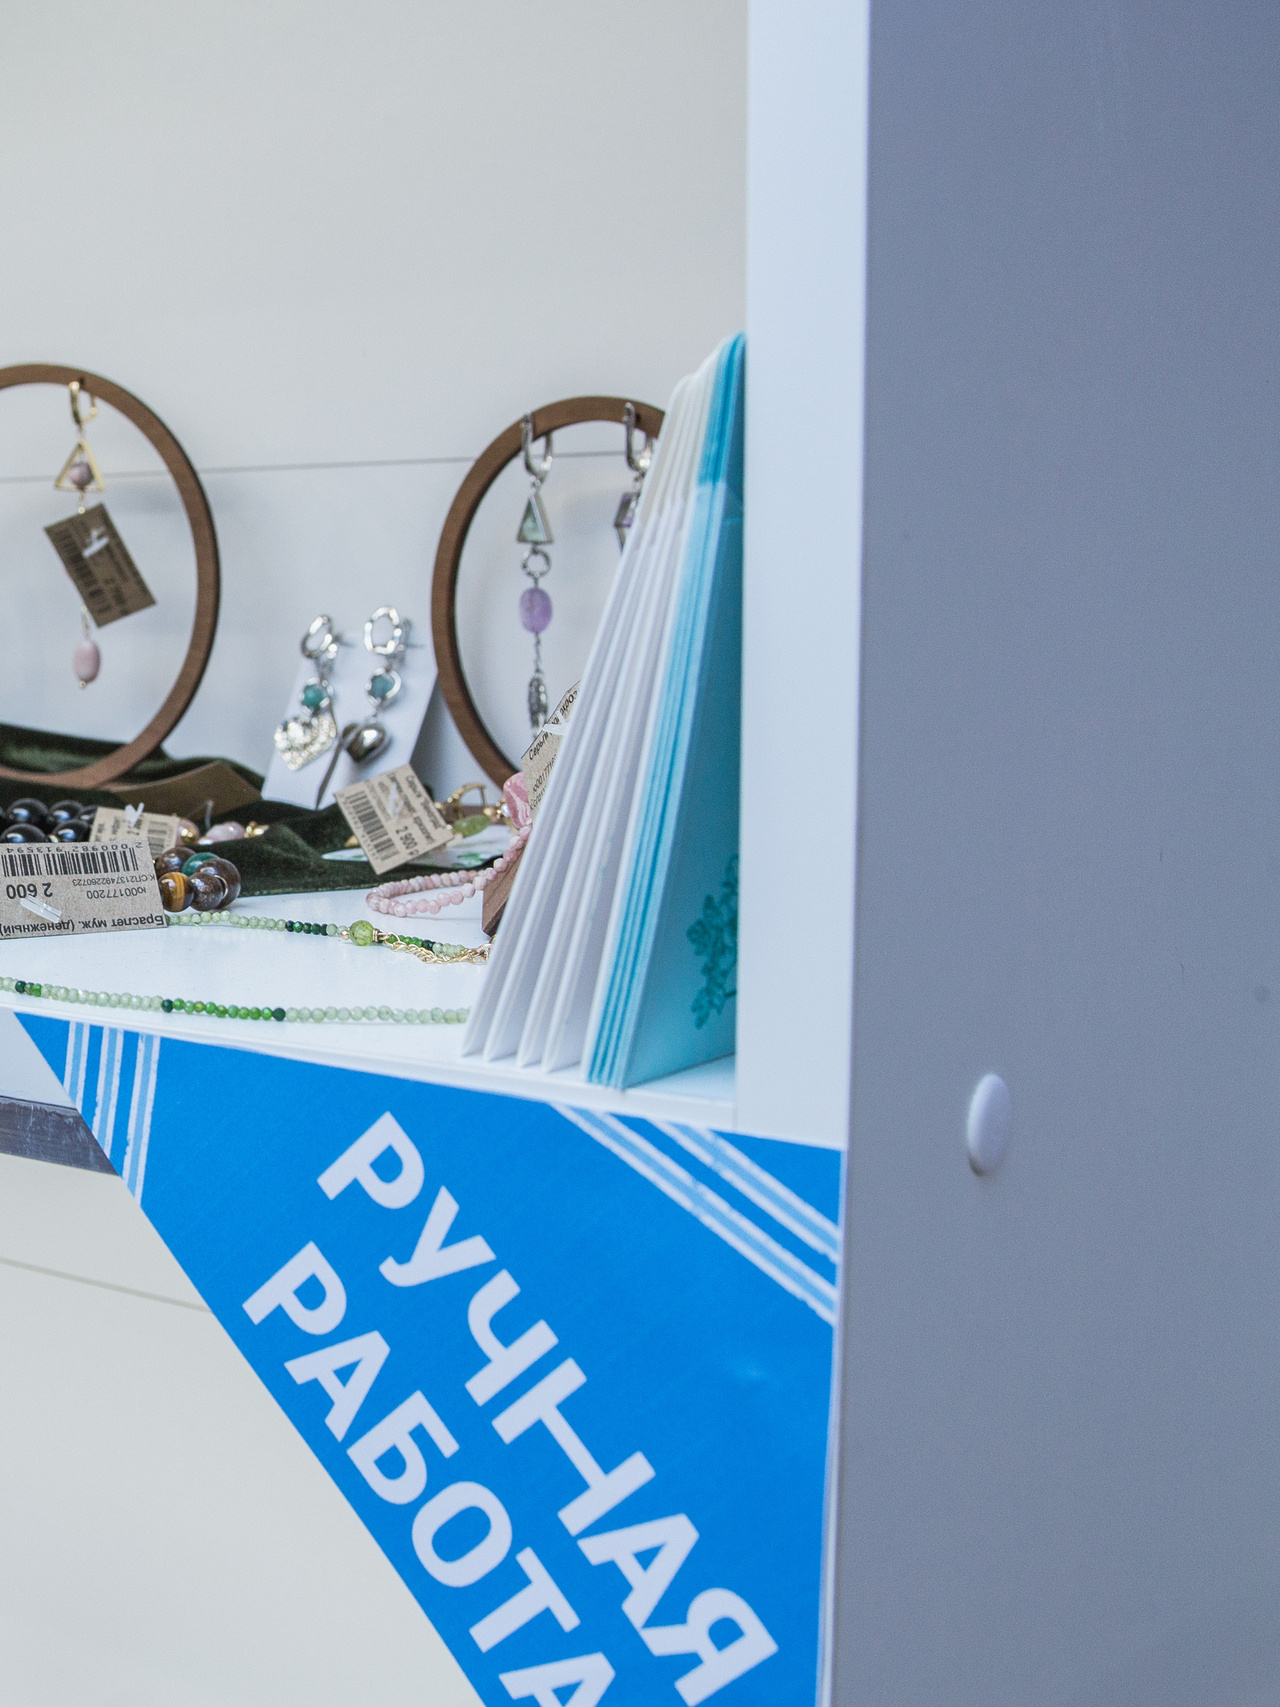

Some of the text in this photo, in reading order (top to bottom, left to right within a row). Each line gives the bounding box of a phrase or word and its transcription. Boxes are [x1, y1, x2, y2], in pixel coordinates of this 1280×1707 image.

[6, 841, 143, 854] 2 000982 913594
[6, 882, 38, 899] 600
[43, 881, 53, 898] 2
[86, 886, 147, 900] ю00177200
[77, 918, 107, 930] муж.
[111, 914, 165, 927] Браслет
[317, 1111, 778, 1707] РУЧНАЯ
